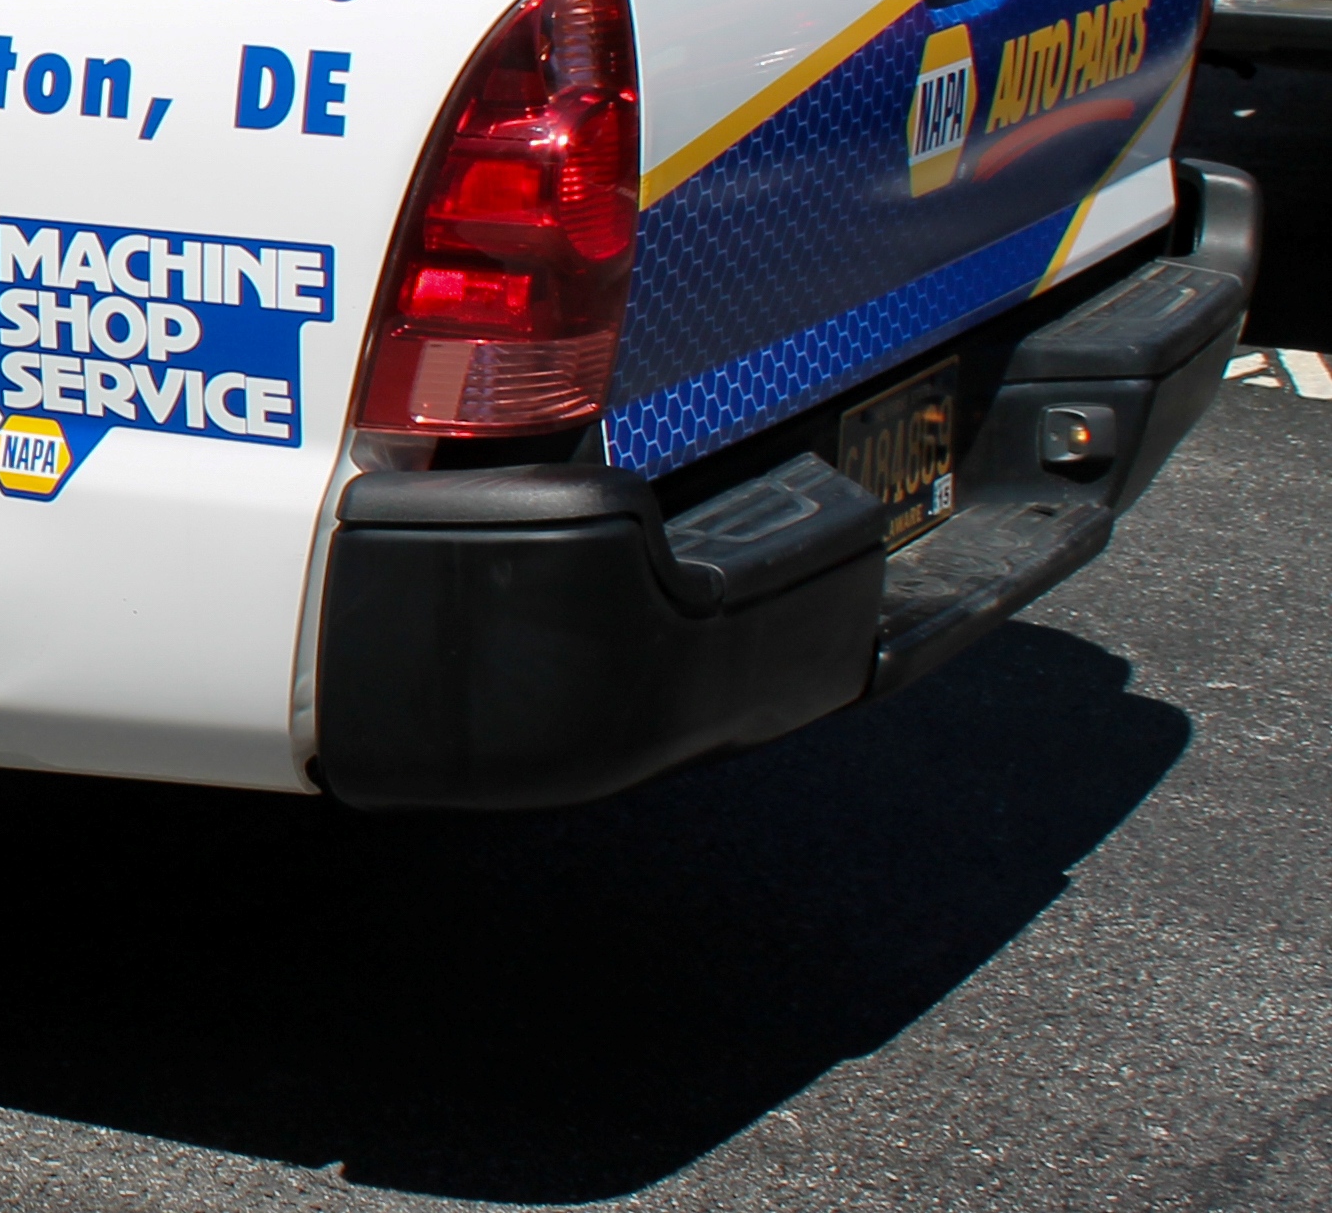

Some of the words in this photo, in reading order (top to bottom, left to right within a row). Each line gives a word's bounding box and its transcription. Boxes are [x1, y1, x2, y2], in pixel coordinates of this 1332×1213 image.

[234, 44, 352, 138] DE
[913, 67, 968, 156] NAPA
[985, 18, 1071, 135] AUTO
[0, 351, 293, 439] SERVICE
[0, 434, 57, 475] NAPA
